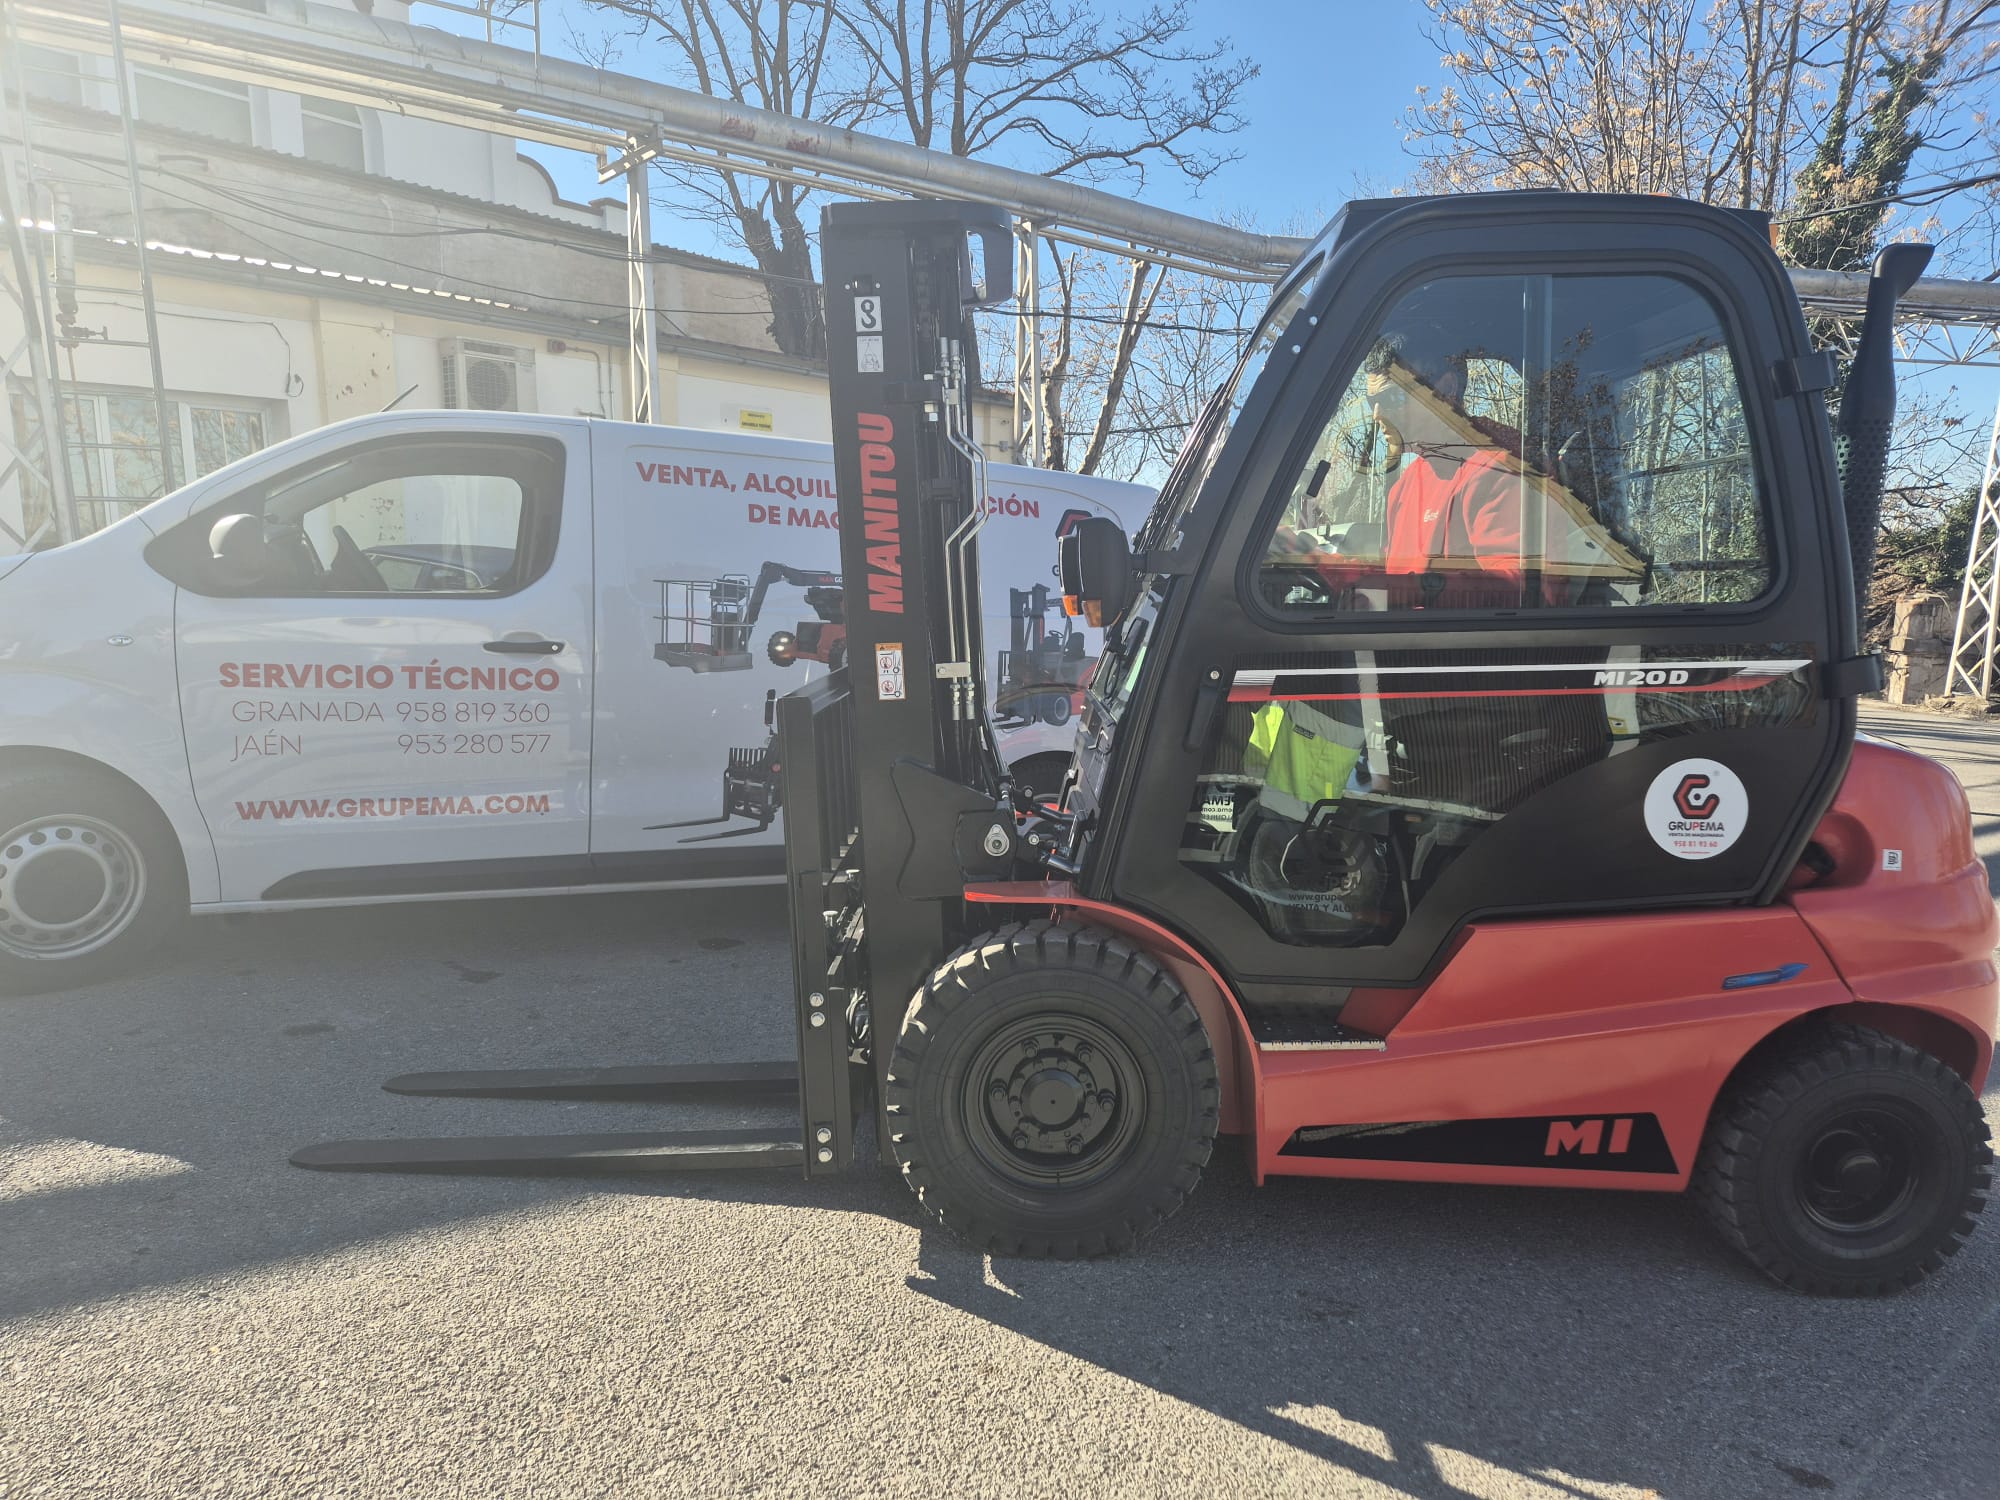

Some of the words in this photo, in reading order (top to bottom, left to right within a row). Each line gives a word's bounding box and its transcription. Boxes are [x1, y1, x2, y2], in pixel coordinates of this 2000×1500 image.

[636, 462, 736, 492] VENTA,
[743, 472, 837, 500] ALQUIL
[976, 492, 1039, 518] CIÓN
[748, 503, 781, 525] DE
[857, 412, 904, 614] MANITOU
[219, 662, 394, 689] SERVICIO
[401, 659, 560, 691] TÉCNICO
[232, 700, 385, 723] GRANADA
[396, 702, 447, 723] 958
[455, 702, 496, 723] 819
[503, 702, 550, 723] 360
[230, 728, 302, 762] JAÉN
[397, 734, 447, 754] 953
[454, 734, 504, 754] 280
[511, 734, 551, 754] 577
[235, 795, 550, 820] WWW.GRUPEMA.COM
[1668, 821, 1725, 831] GRUPEMA
[1544, 1119, 1633, 1156] MI
